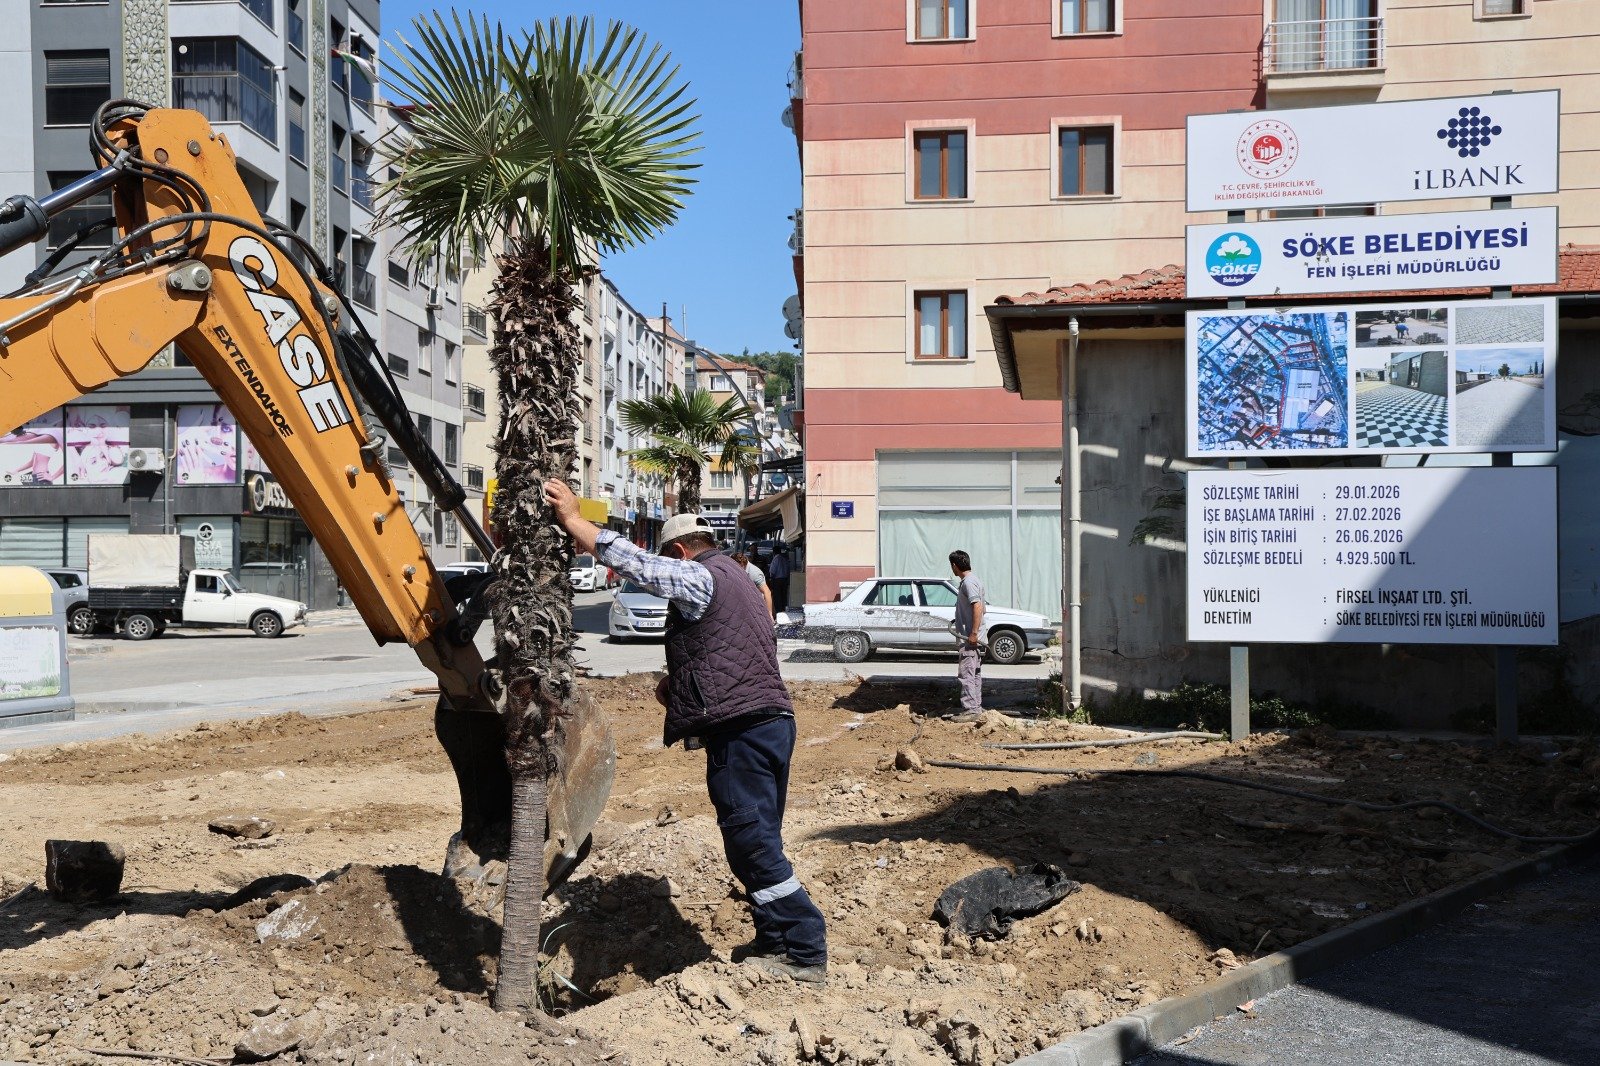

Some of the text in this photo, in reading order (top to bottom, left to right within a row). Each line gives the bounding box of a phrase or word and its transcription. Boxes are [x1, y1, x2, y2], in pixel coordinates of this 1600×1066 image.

[1264, 180, 1304, 190] ŞEHİRCİLİK
[1282, 188, 1323, 197] BAKANLIĞI
[1282, 221, 1527, 258] SÖKE BELEDİYESİ
[1210, 262, 1259, 276] SÖKE
[1307, 255, 1501, 280] FEN İŞLERİ MÜDÜRLÜĞÜ
[228, 235, 353, 434] CASE
[213, 325, 293, 438] EXTENDAHOE
[1203, 484, 1260, 502] SÖZLEŞME
[1263, 484, 1299, 500] TARİHİ
[1335, 485, 1400, 499] 29.01.2026
[1203, 506, 1221, 524] İŞE
[1224, 508, 1276, 524] BAŞLAMA
[1278, 505, 1314, 521] TARİHİ
[1335, 507, 1401, 521] 27.02.2026
[1203, 527, 1226, 545] İŞİN
[1230, 527, 1258, 545] BİTİŞ
[1261, 527, 1297, 543] TARİHİ
[1335, 529, 1403, 543] 26.06.2026
[1203, 549, 1260, 567] SÖZLEŞME
[1264, 549, 1303, 565] BEDELİ
[1336, 551, 1396, 565] 4.929.500
[1399, 551, 1416, 565] TL.
[1203, 587, 1260, 603] YÜKLENİCİ
[1336, 588, 1375, 604] FİRSEL
[1378, 588, 1419, 606] İNŞAAT
[1422, 590, 1446, 604] LTD.
[1450, 588, 1472, 607] ŞTİ.
[1204, 609, 1252, 624] DENETİM
[1336, 610, 1361, 626] SÖKE
[1365, 610, 1420, 626] BELEDİYESİ
[1423, 612, 1442, 626] FEN
[1445, 610, 1477, 629] İŞLERİ
[1480, 611, 1545, 628] MÜDÜRLÜĞÜ
